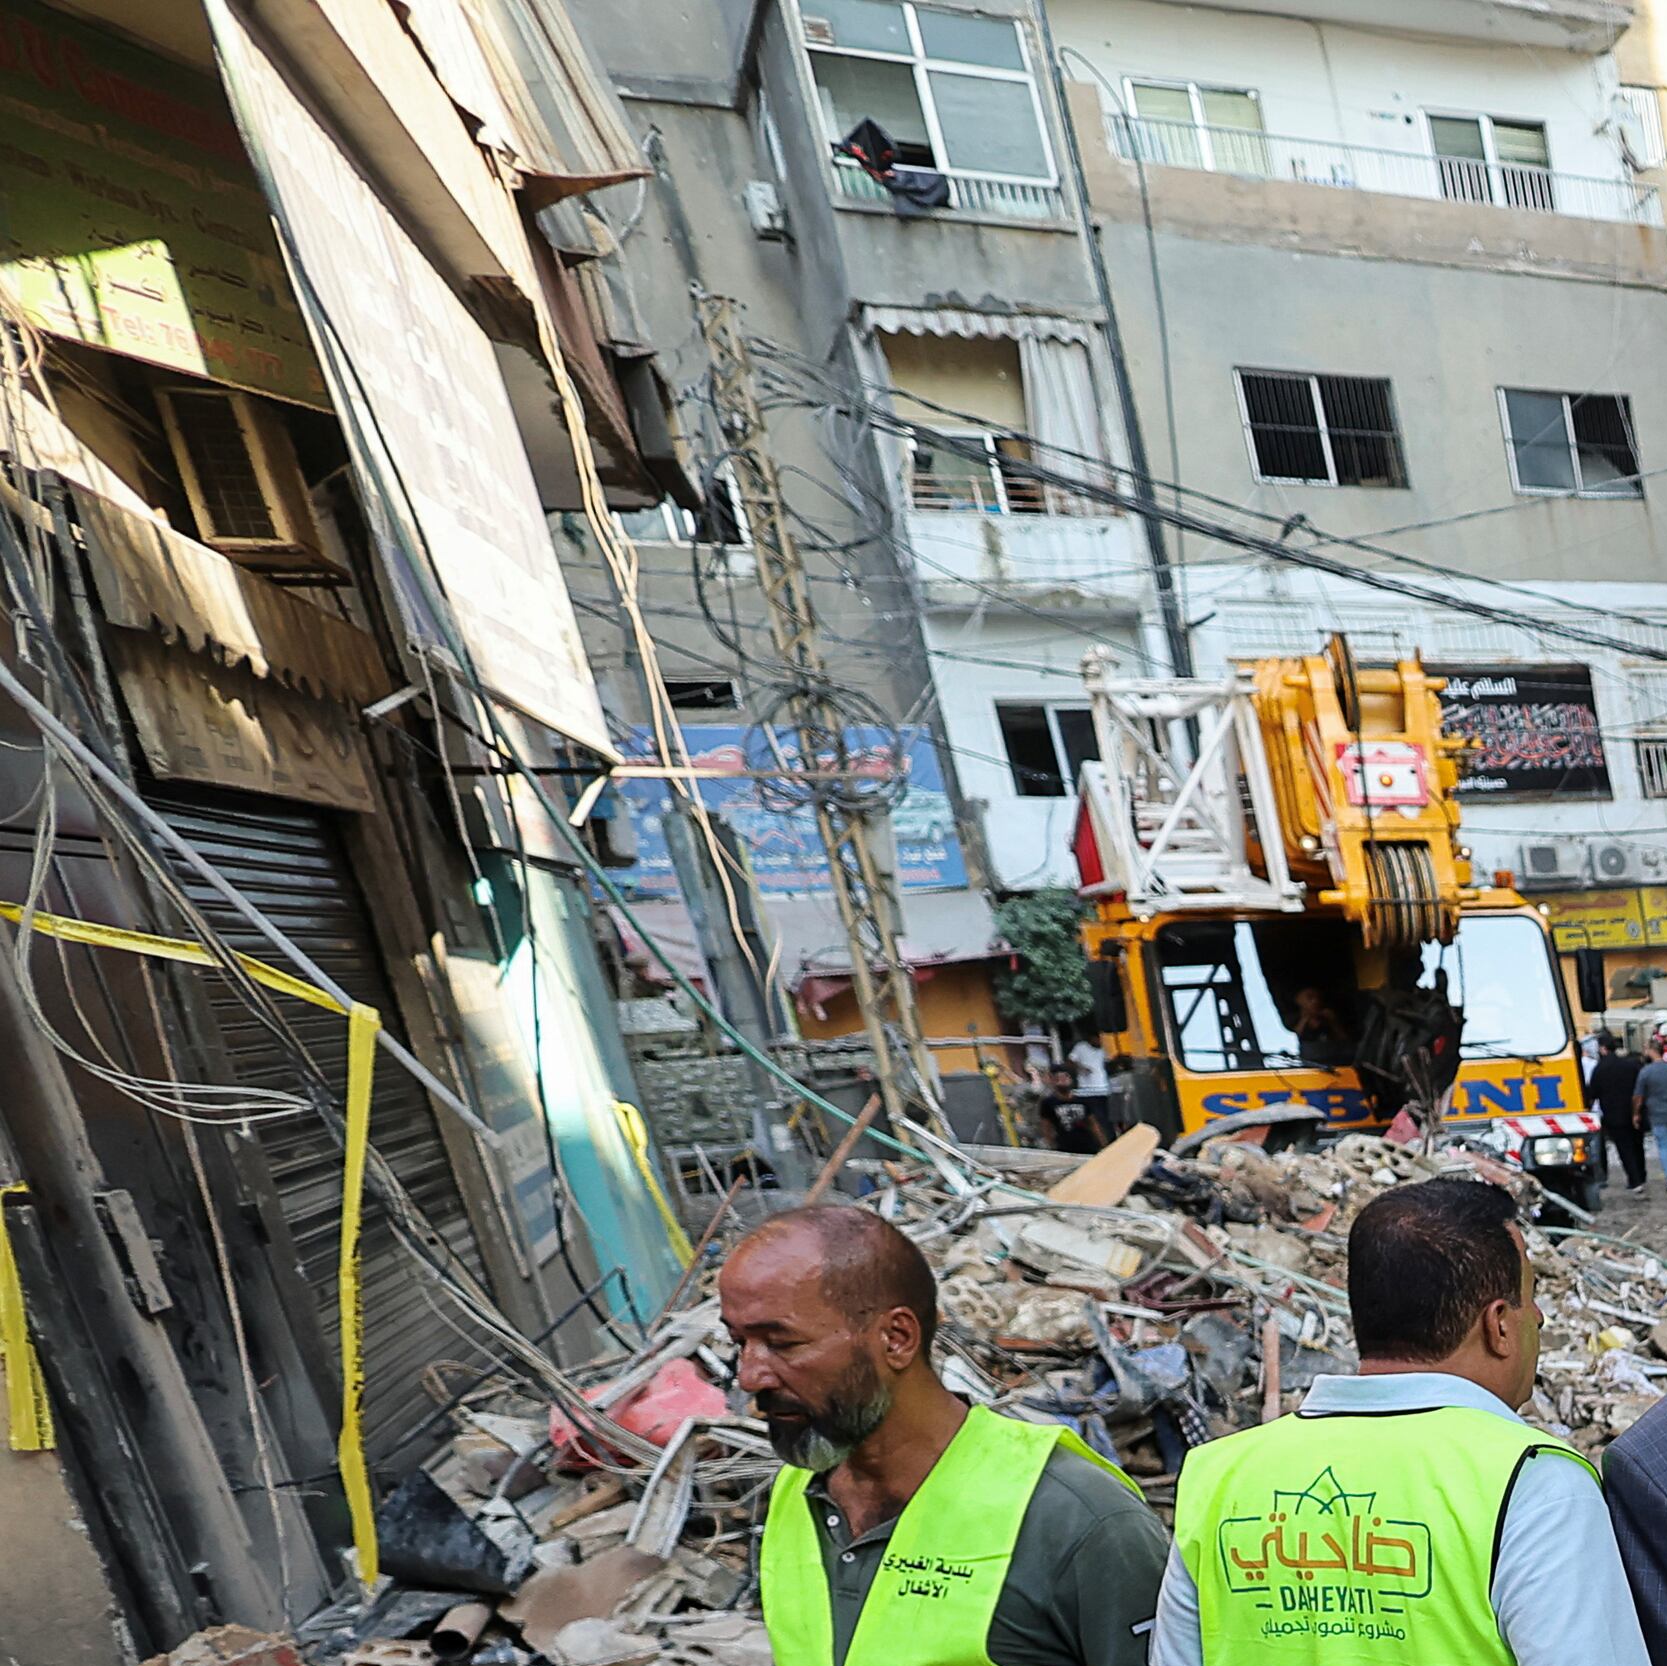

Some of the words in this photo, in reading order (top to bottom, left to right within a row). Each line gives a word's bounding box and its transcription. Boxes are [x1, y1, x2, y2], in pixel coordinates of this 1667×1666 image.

[1202, 1074, 1566, 1126] SBNI
[1231, 1512, 1416, 1581] ضاحيتي
[935, 1557, 974, 1584] بلدية
[1280, 1586, 1374, 1614] DAHEYATI
[1358, 1618, 1406, 1641] مشروع
